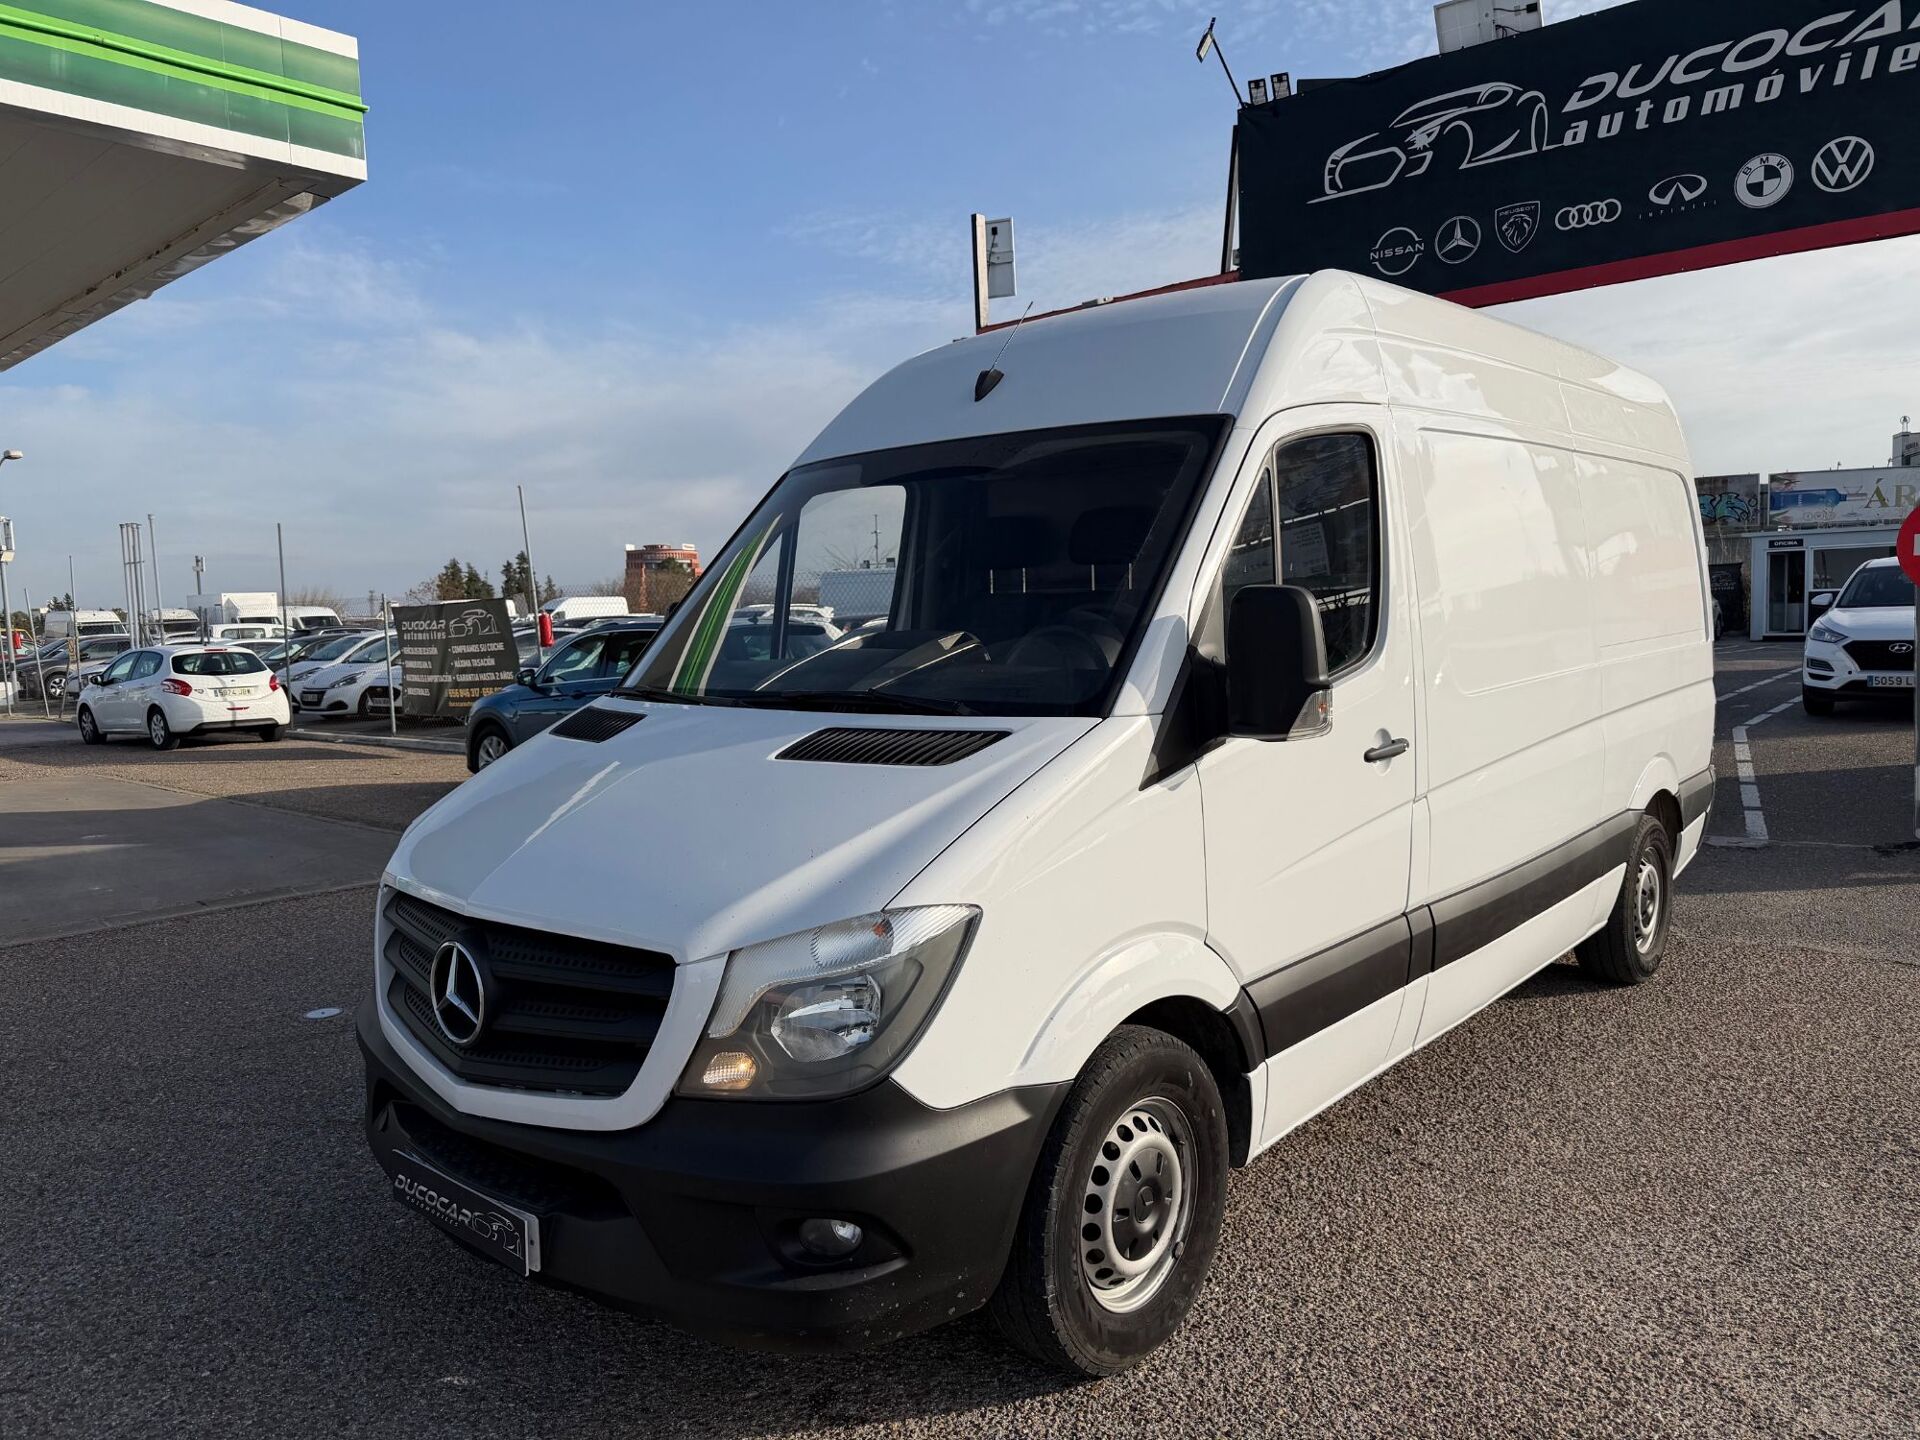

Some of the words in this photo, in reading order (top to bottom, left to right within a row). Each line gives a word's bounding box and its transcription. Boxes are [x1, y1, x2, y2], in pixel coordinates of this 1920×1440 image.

[1562, 0, 1920, 113] DUCOCA
[1741, 155, 1788, 177] BMW
[1498, 205, 1537, 217] PEUGEOT
[1370, 242, 1425, 261] NISSAN
[401, 619, 447, 631] DUCOCAR
[487, 642, 505, 651] COCHE
[1874, 676, 1903, 686] 5059
[394, 1174, 472, 1227] DUCOCAR
